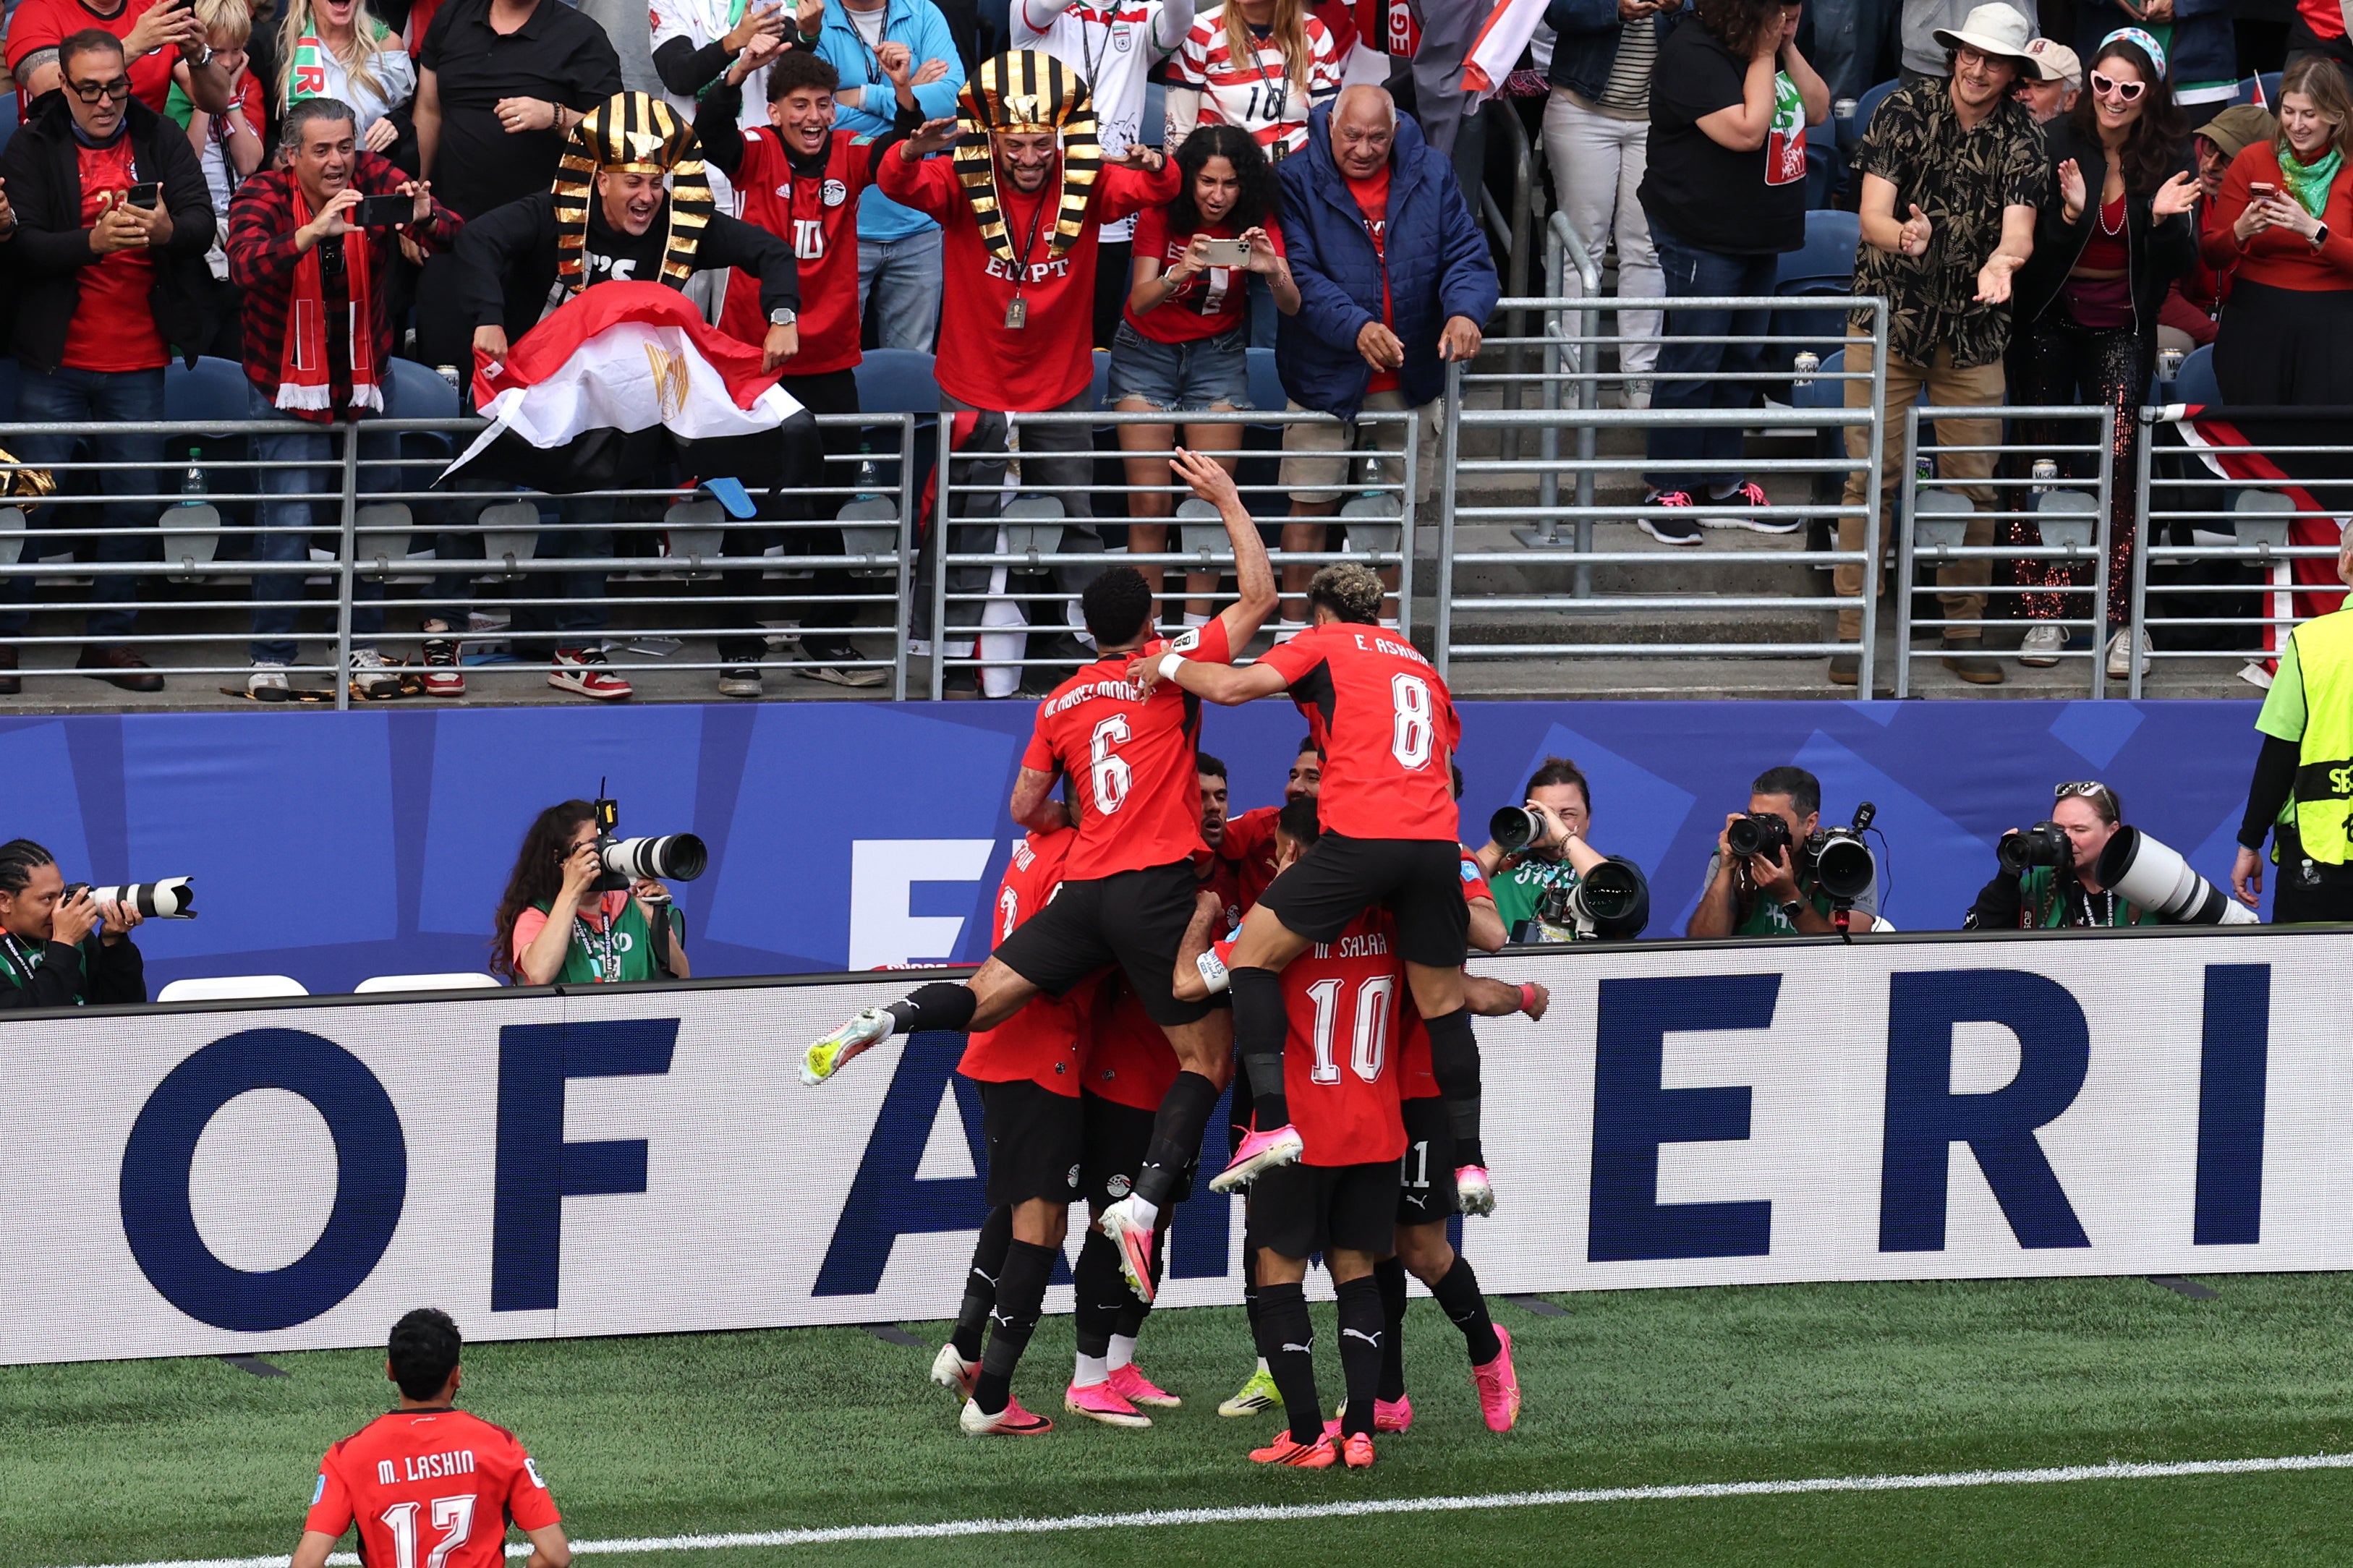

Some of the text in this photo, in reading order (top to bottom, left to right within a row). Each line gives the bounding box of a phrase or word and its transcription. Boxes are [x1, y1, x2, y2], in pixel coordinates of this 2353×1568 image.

[1246, 86, 1284, 122] 10
[793, 219, 823, 259] 10
[1355, 634, 1372, 651] E.
[1391, 672, 1434, 772] 8
[1089, 713, 1132, 816] 6
[1340, 933, 1387, 958] SALAH
[1306, 975, 1395, 1084] 10
[119, 1018, 681, 1332] OF
[378, 1449, 475, 1485] M. LASHIN
[380, 1494, 477, 1568] 17
